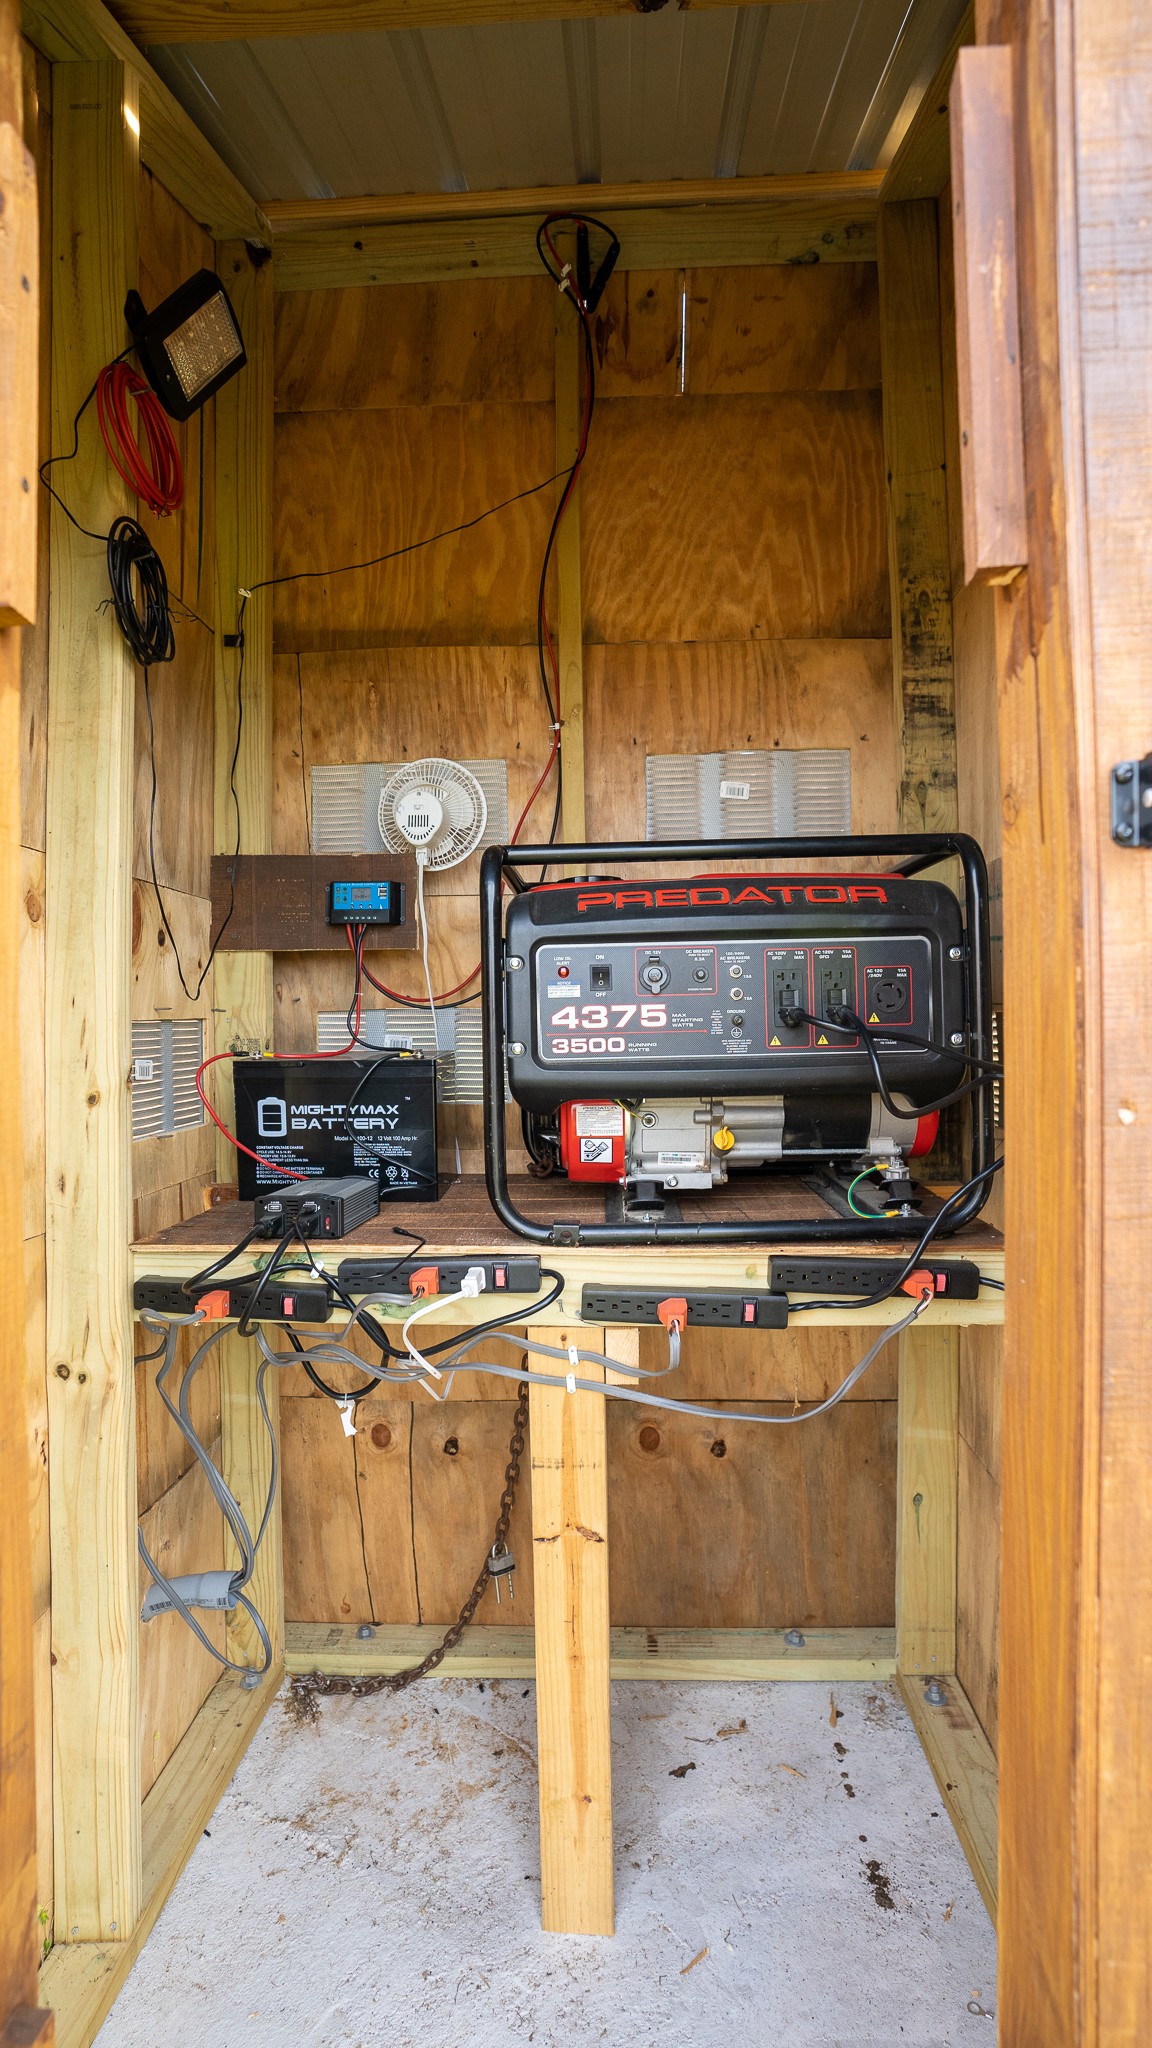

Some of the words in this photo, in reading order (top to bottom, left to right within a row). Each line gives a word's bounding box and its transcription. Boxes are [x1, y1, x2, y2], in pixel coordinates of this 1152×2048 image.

[577, 885, 888, 912] PREDATOR
[551, 1004, 667, 1029] 4375
[552, 1037, 625, 1054] 3500
[291, 1105, 399, 1114] MIGHTYMAX
